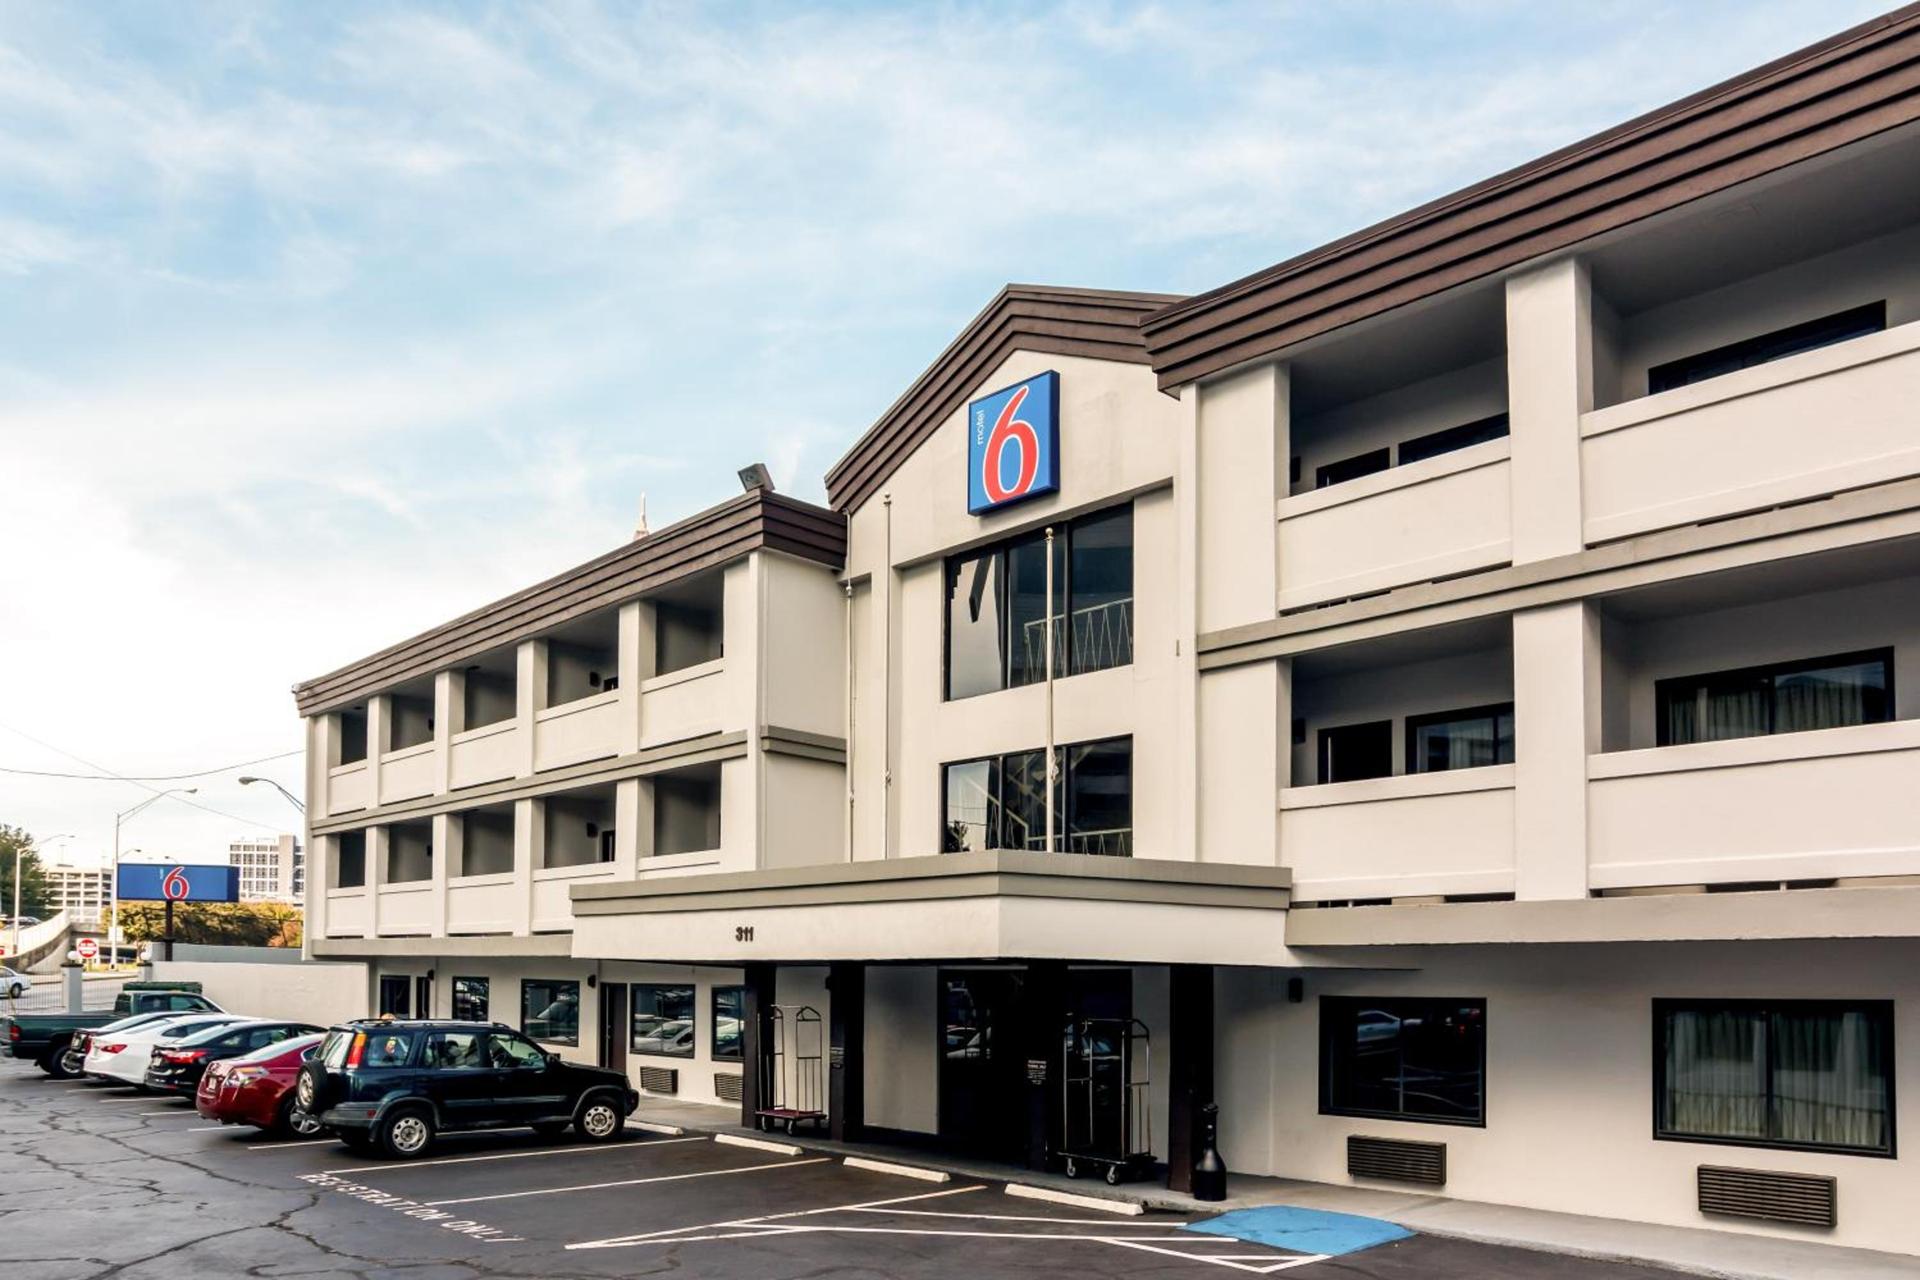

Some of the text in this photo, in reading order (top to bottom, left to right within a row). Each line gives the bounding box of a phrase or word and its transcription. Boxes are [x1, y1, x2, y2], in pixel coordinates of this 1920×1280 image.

[976, 409, 985, 445] motel
[983, 385, 1040, 503] 6
[162, 866, 190, 900] 6
[735, 926, 754, 942] 311
[295, 1173, 455, 1221] REGISTRATION
